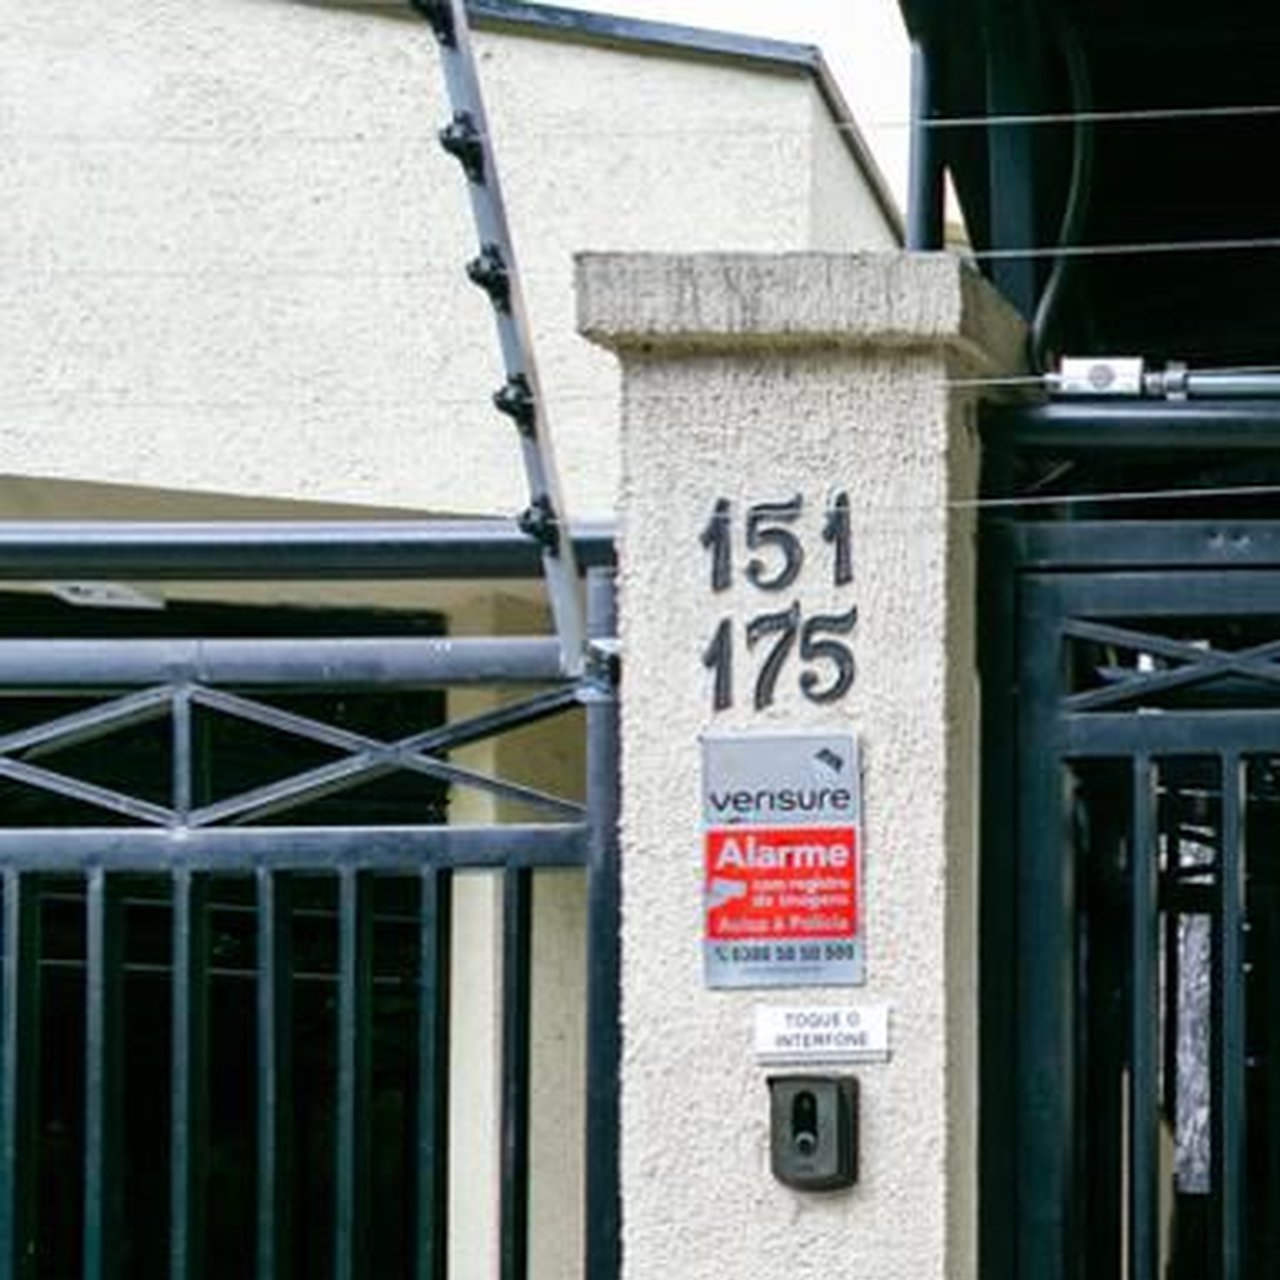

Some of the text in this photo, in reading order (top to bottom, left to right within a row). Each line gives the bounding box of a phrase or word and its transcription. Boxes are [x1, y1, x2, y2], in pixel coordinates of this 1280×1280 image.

[700, 492, 853, 593] 151
[702, 600, 858, 712] 175
[709, 787, 850, 812] verisure
[716, 836, 850, 869] Alarme
[785, 1011, 840, 1029] TOQUE
[776, 1030, 869, 1047] INTERFONE
